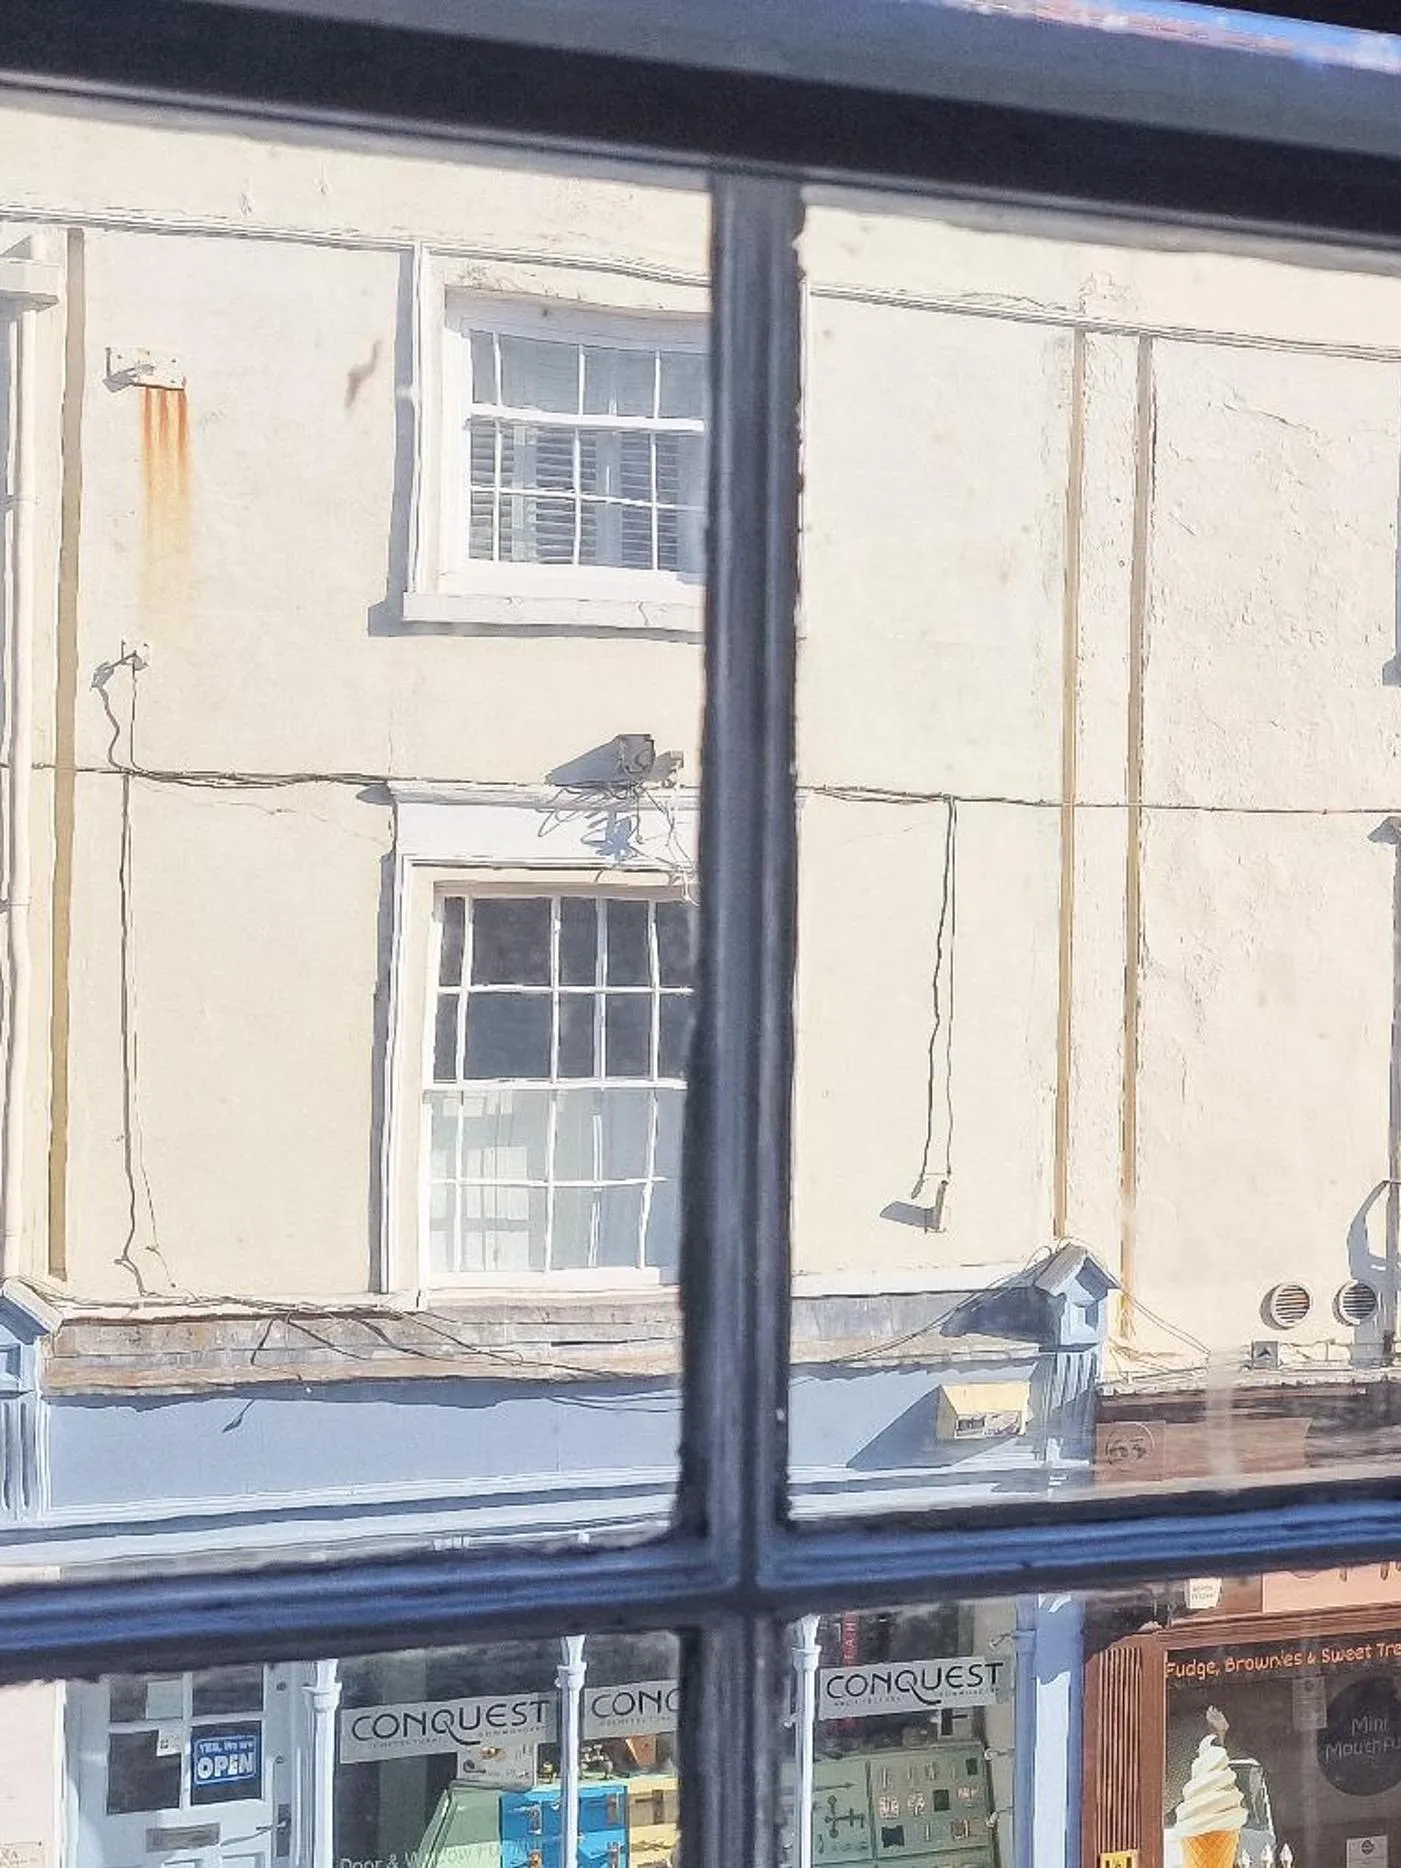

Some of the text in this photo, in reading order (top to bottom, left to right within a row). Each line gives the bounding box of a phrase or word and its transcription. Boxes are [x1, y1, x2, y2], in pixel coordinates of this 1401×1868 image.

[1166, 1658, 1220, 1681] Fudge,
[1225, 1649, 1303, 1672] Brownies
[1321, 1643, 1372, 1664] Sweet
[827, 1662, 1004, 1705] CONQUEST
[352, 1701, 550, 1745] CONQUEST
[197, 1752, 254, 1779] OPEN
